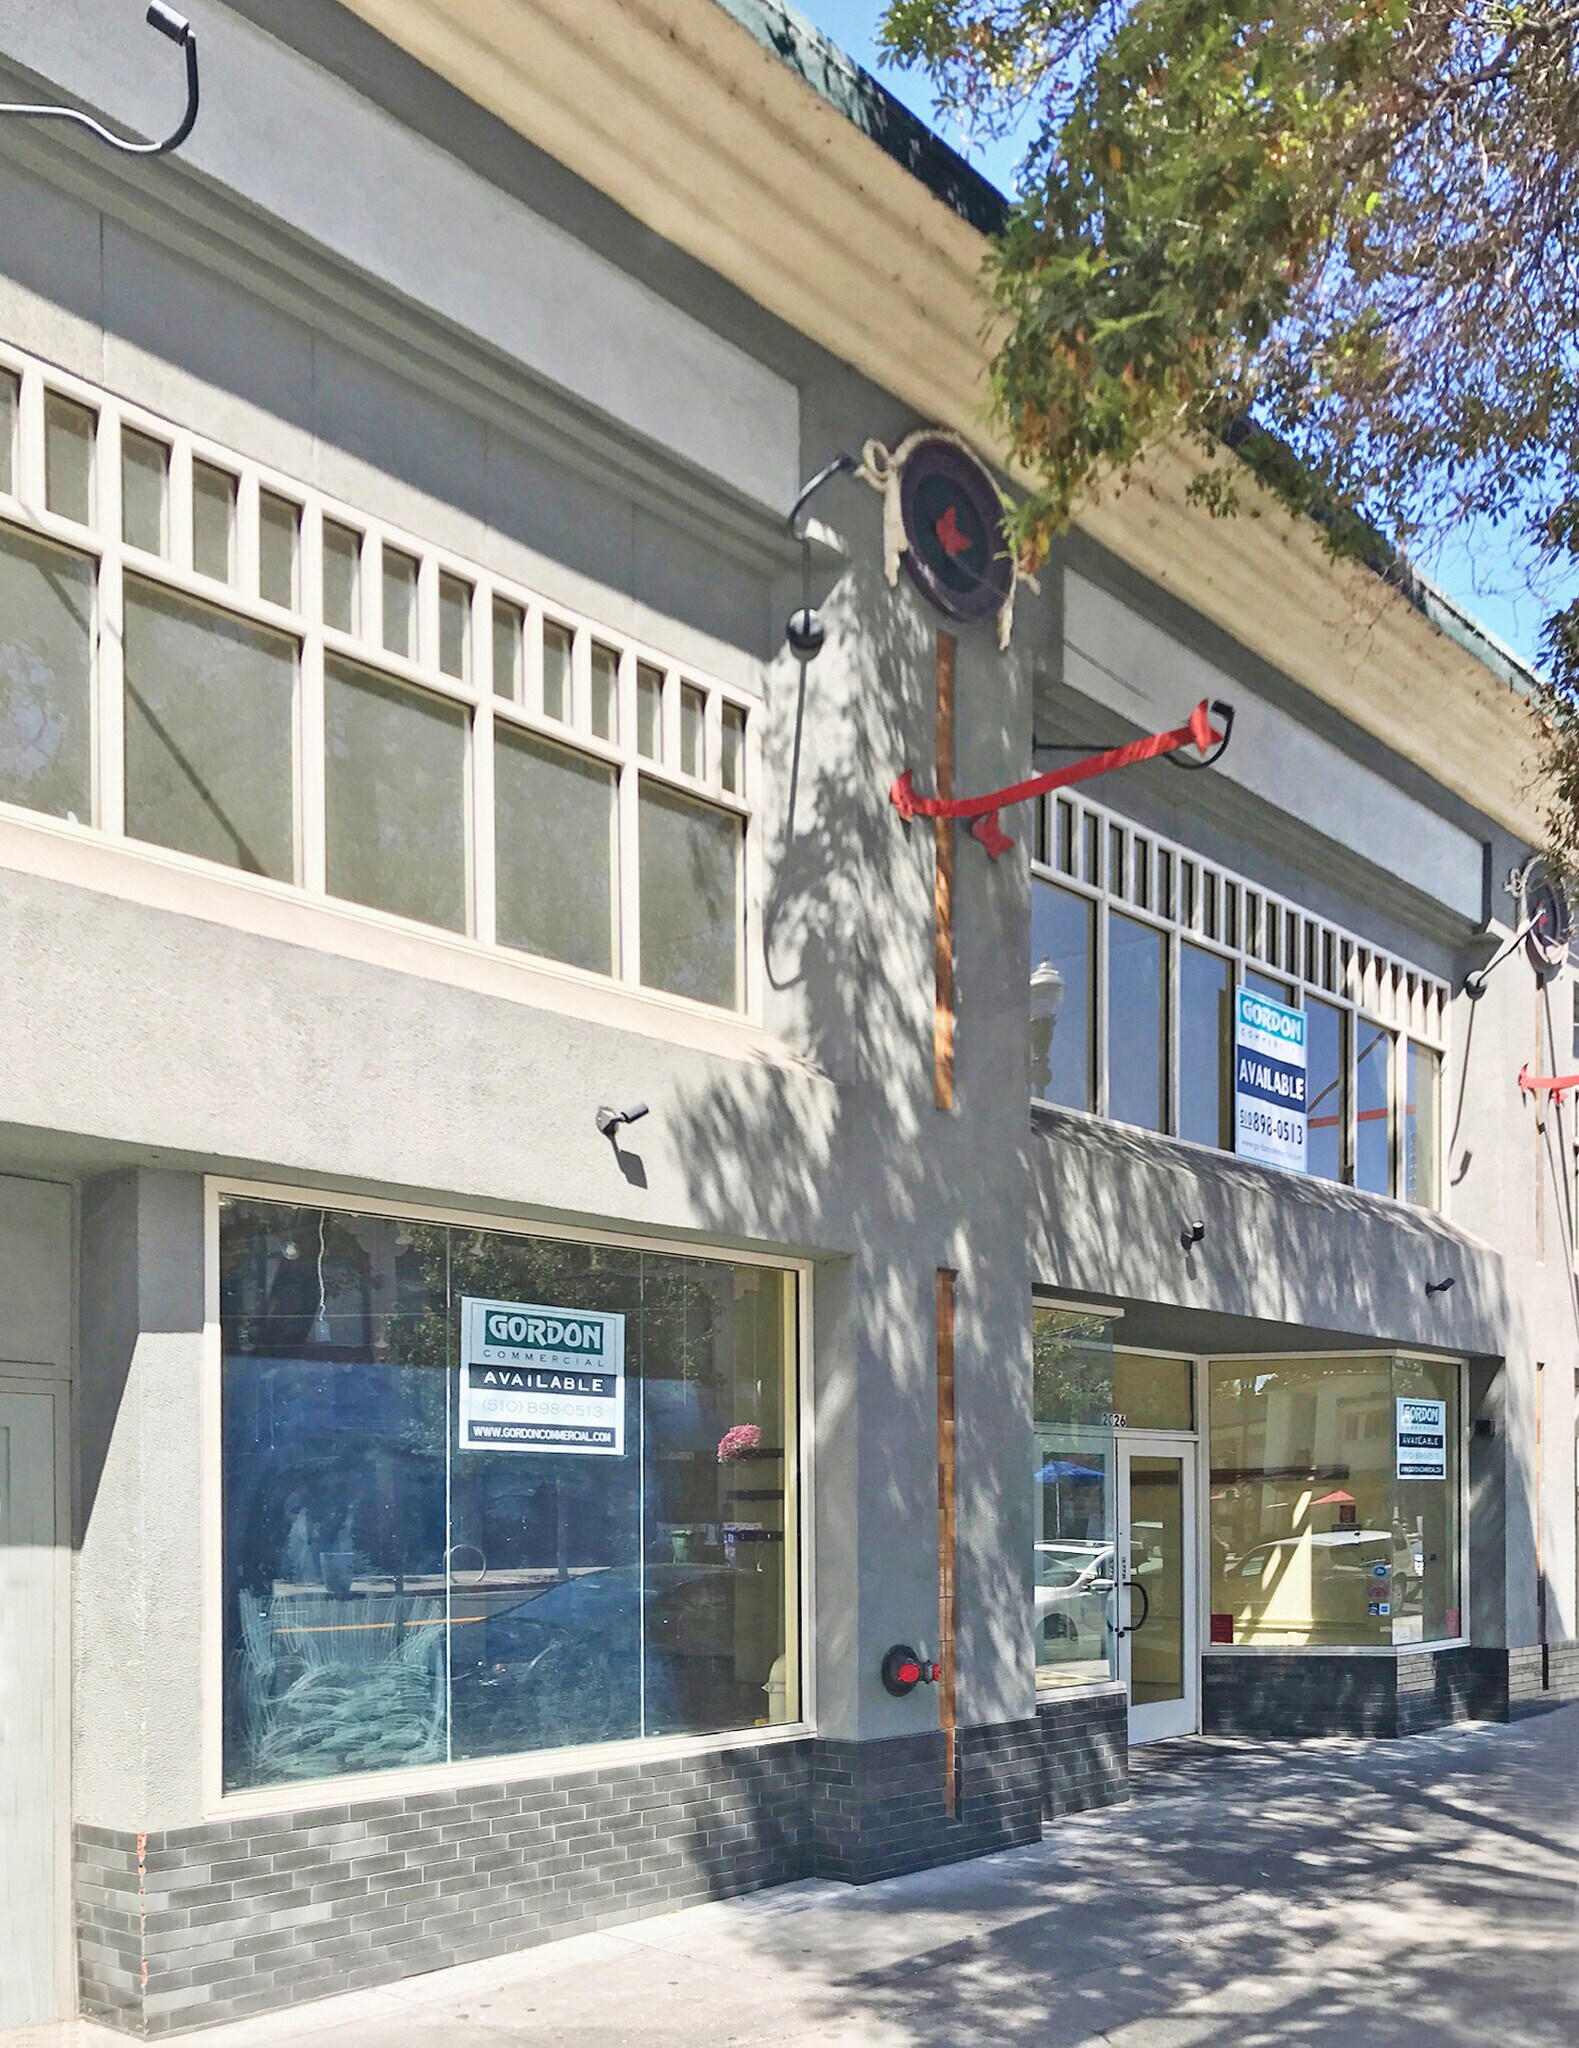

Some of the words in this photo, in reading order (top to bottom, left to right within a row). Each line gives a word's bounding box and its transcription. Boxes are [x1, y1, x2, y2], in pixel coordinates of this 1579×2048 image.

[1242, 1000, 1302, 1041] GORDON
[1239, 1059, 1304, 1101] AVAILABLE
[1253, 1112, 1303, 1145] 898-0513
[488, 1314, 601, 1349] GORDON
[483, 1349, 604, 1368] COMMERCIAL
[483, 1371, 604, 1392] AVAILABLE
[482, 1399, 523, 1414] (510)
[526, 1401, 604, 1418] 898-0513
[473, 1426, 612, 1443] WWW.GORDONCOMMERCIAL.COM
